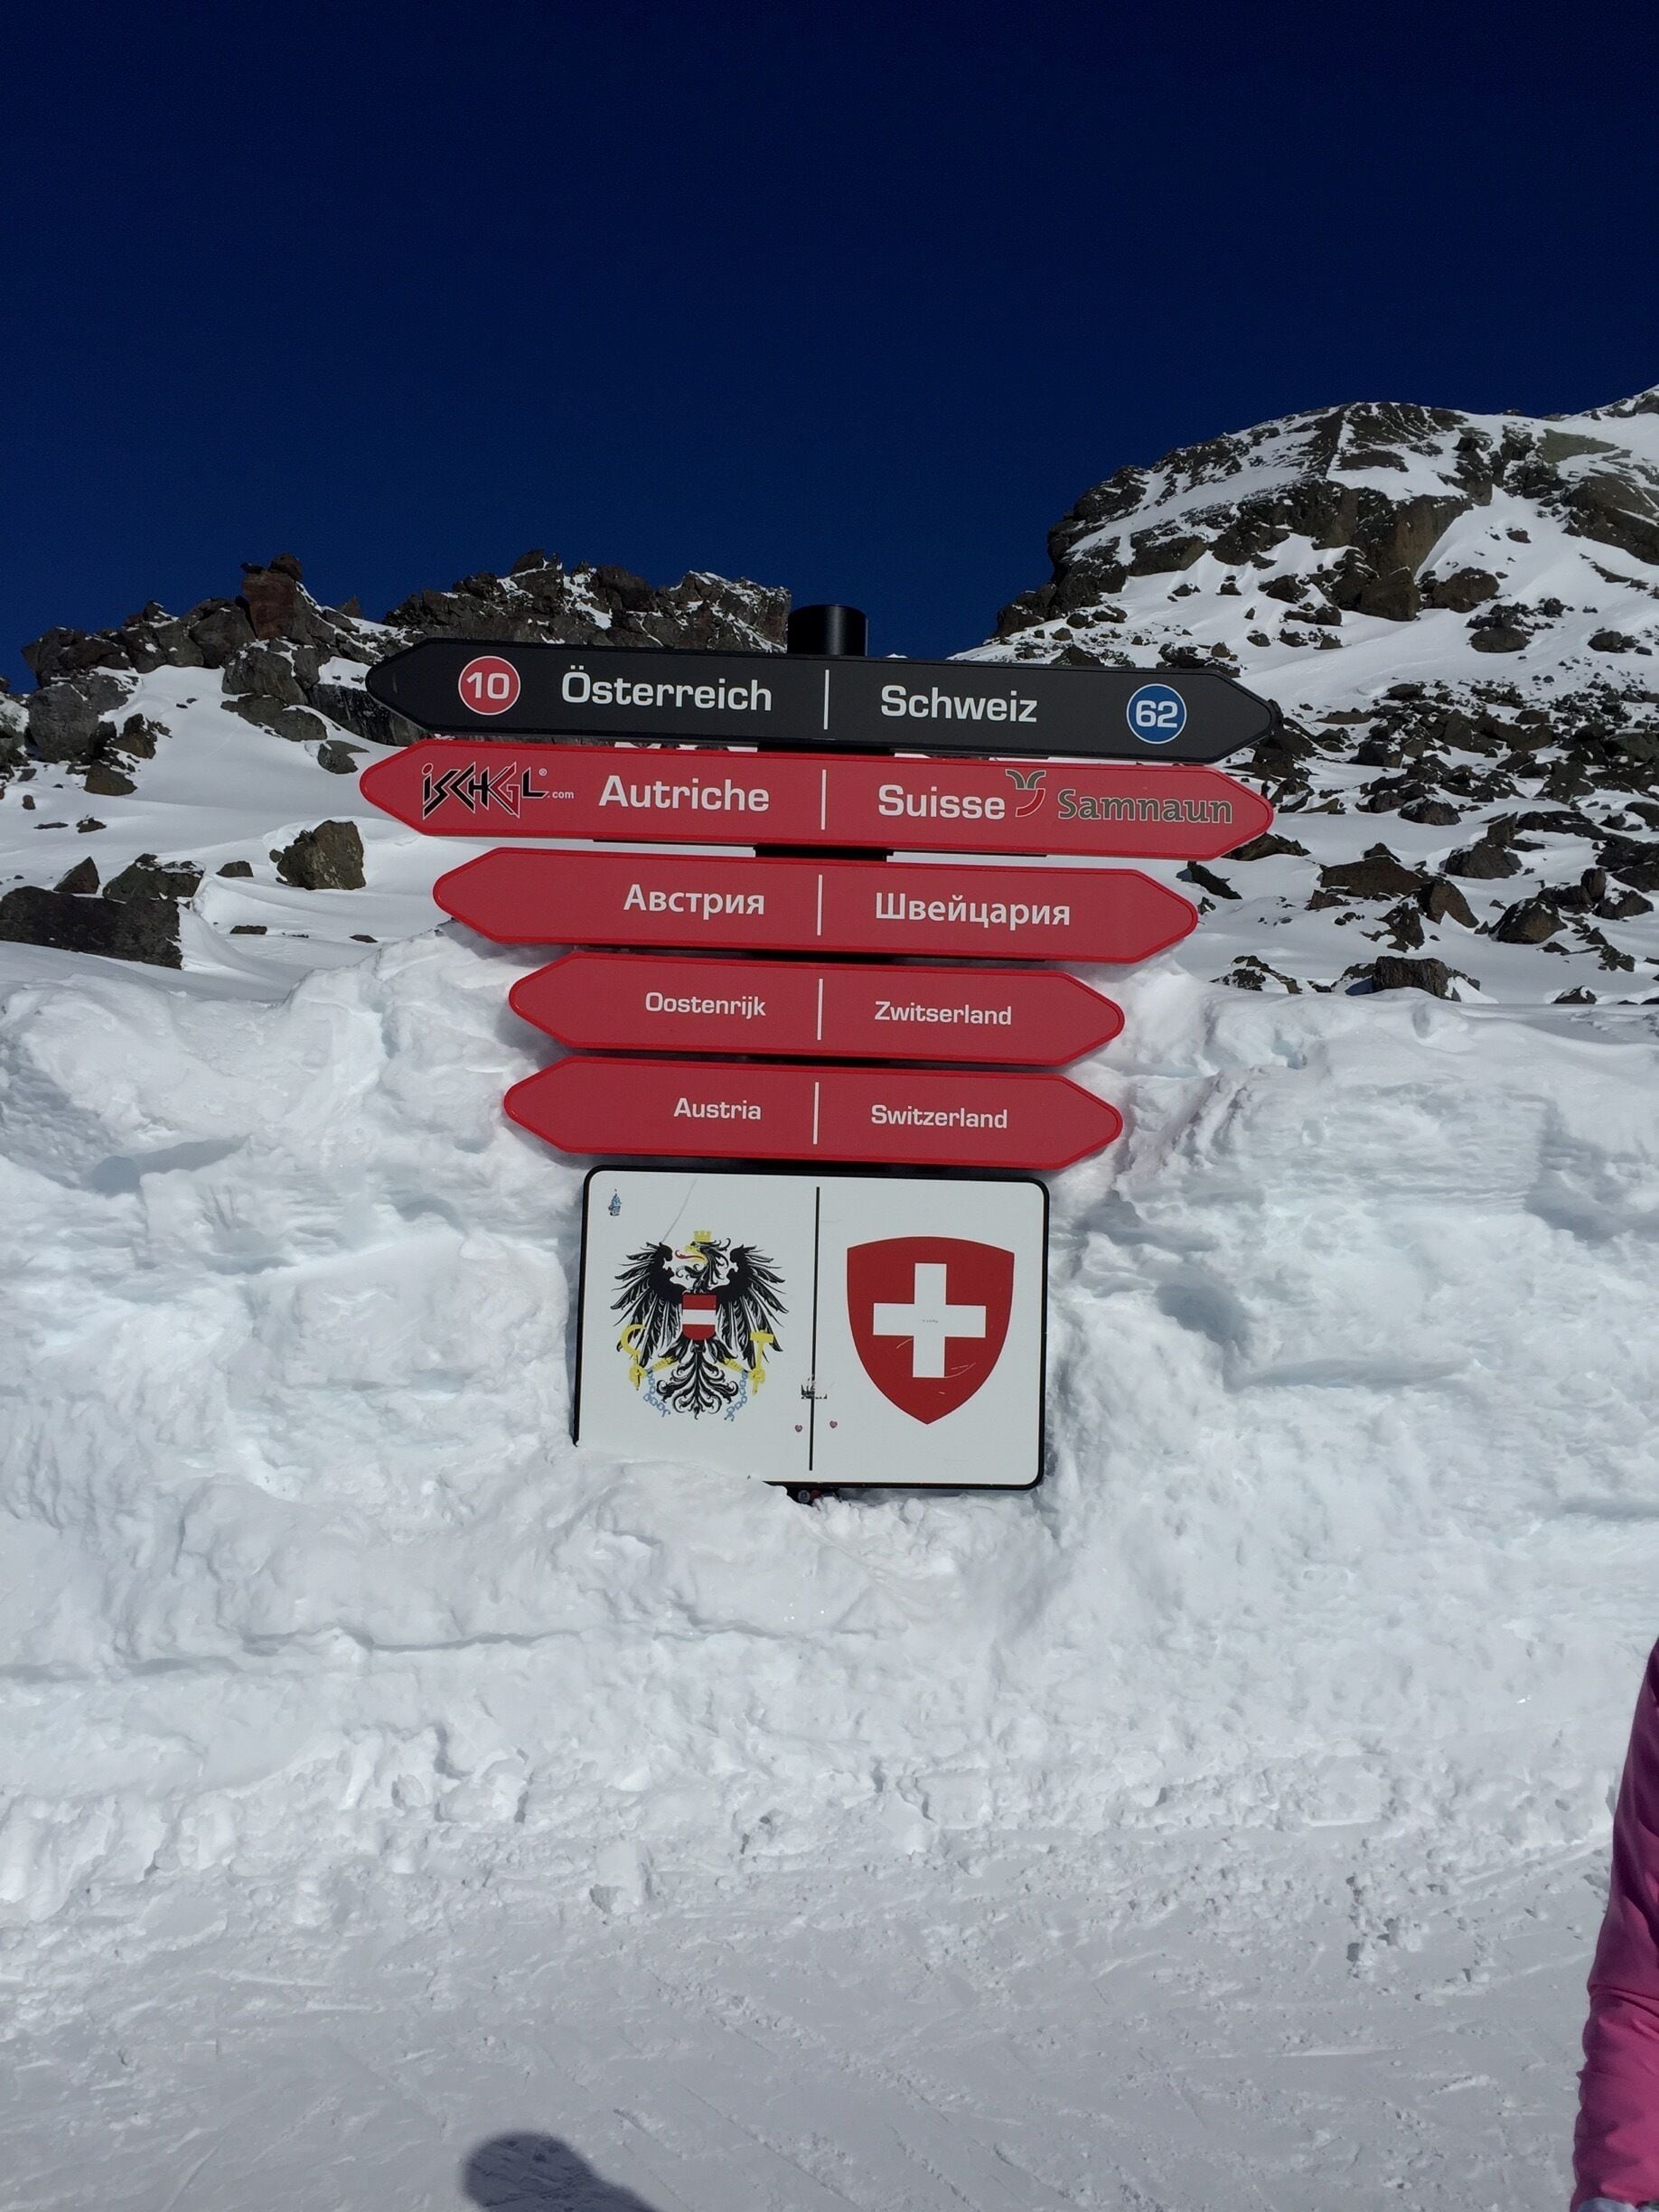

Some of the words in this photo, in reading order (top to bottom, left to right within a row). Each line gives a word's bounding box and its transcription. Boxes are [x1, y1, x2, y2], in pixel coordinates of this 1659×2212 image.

[466, 671, 511, 700] 10
[561, 664, 773, 711] Österreich
[880, 684, 1038, 724] Schweiz
[1135, 699, 1178, 728] 62
[598, 774, 770, 812] Autriche
[877, 783, 1006, 820] Suisse
[1056, 788, 1233, 824] Samnaun
[623, 883, 765, 920] Австрия
[875, 892, 1072, 931] Швейцария
[645, 991, 766, 1018] Oostenrijk
[875, 1000, 1013, 1026] Zwitserland
[673, 1097, 762, 1120] Austria
[871, 1104, 1008, 1129] Switzerland
